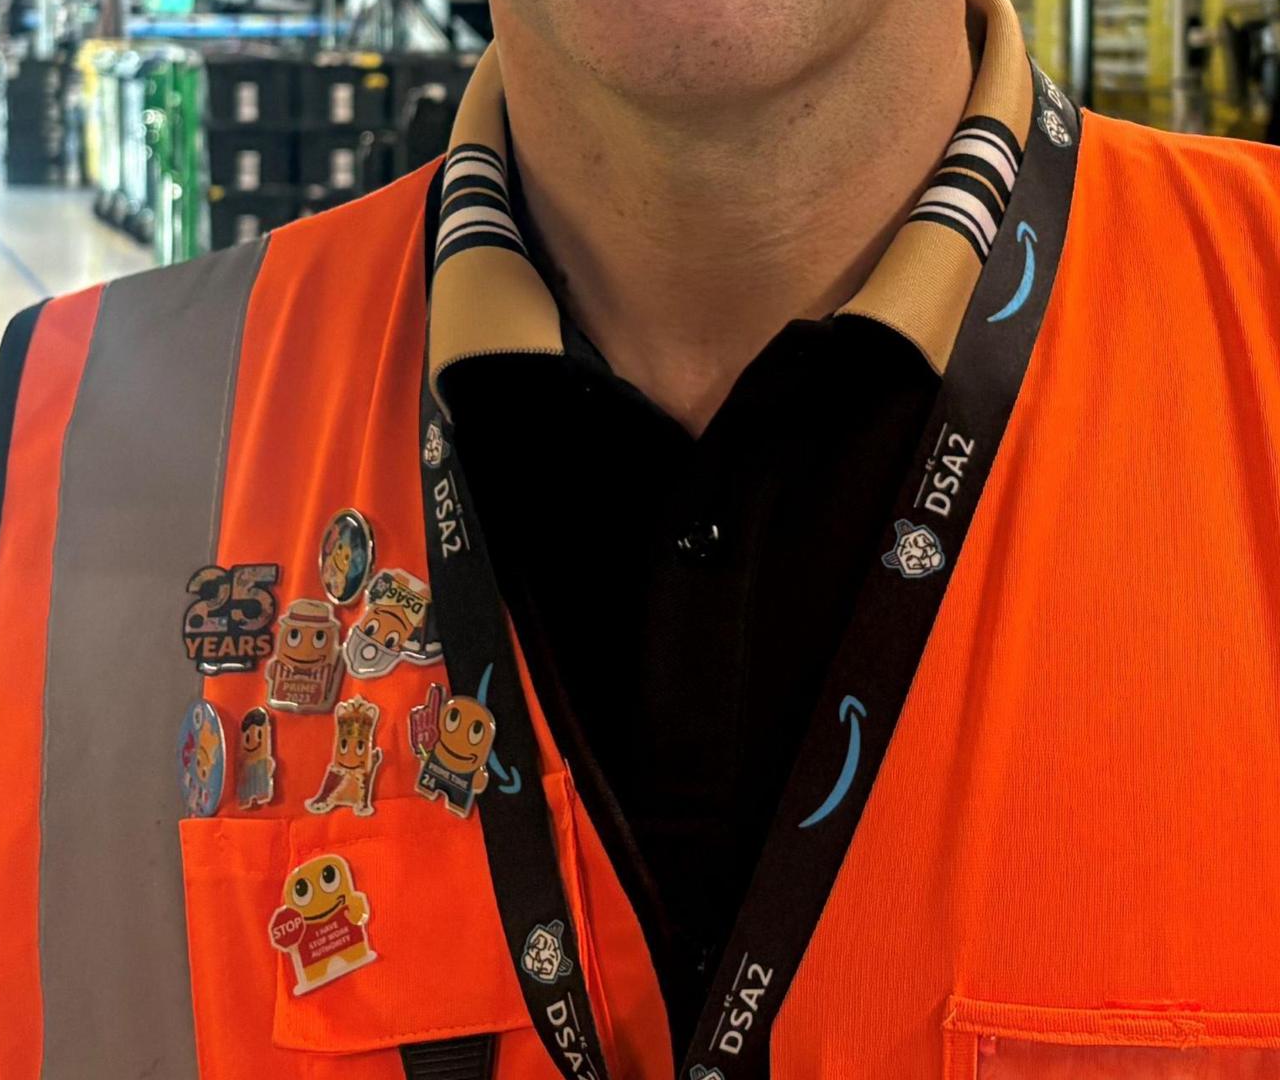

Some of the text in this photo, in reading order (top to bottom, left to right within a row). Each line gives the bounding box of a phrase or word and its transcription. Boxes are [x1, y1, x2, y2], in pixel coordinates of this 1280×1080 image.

[924, 432, 975, 517] DSA2
[433, 478, 462, 559] DSA2
[185, 566, 277, 632] 25
[185, 634, 271, 659] YEARS
[282, 681, 318, 693] PRIME
[422, 773, 436, 790] 24
[272, 917, 302, 940] STOP
[719, 963, 774, 1055] DSA2
